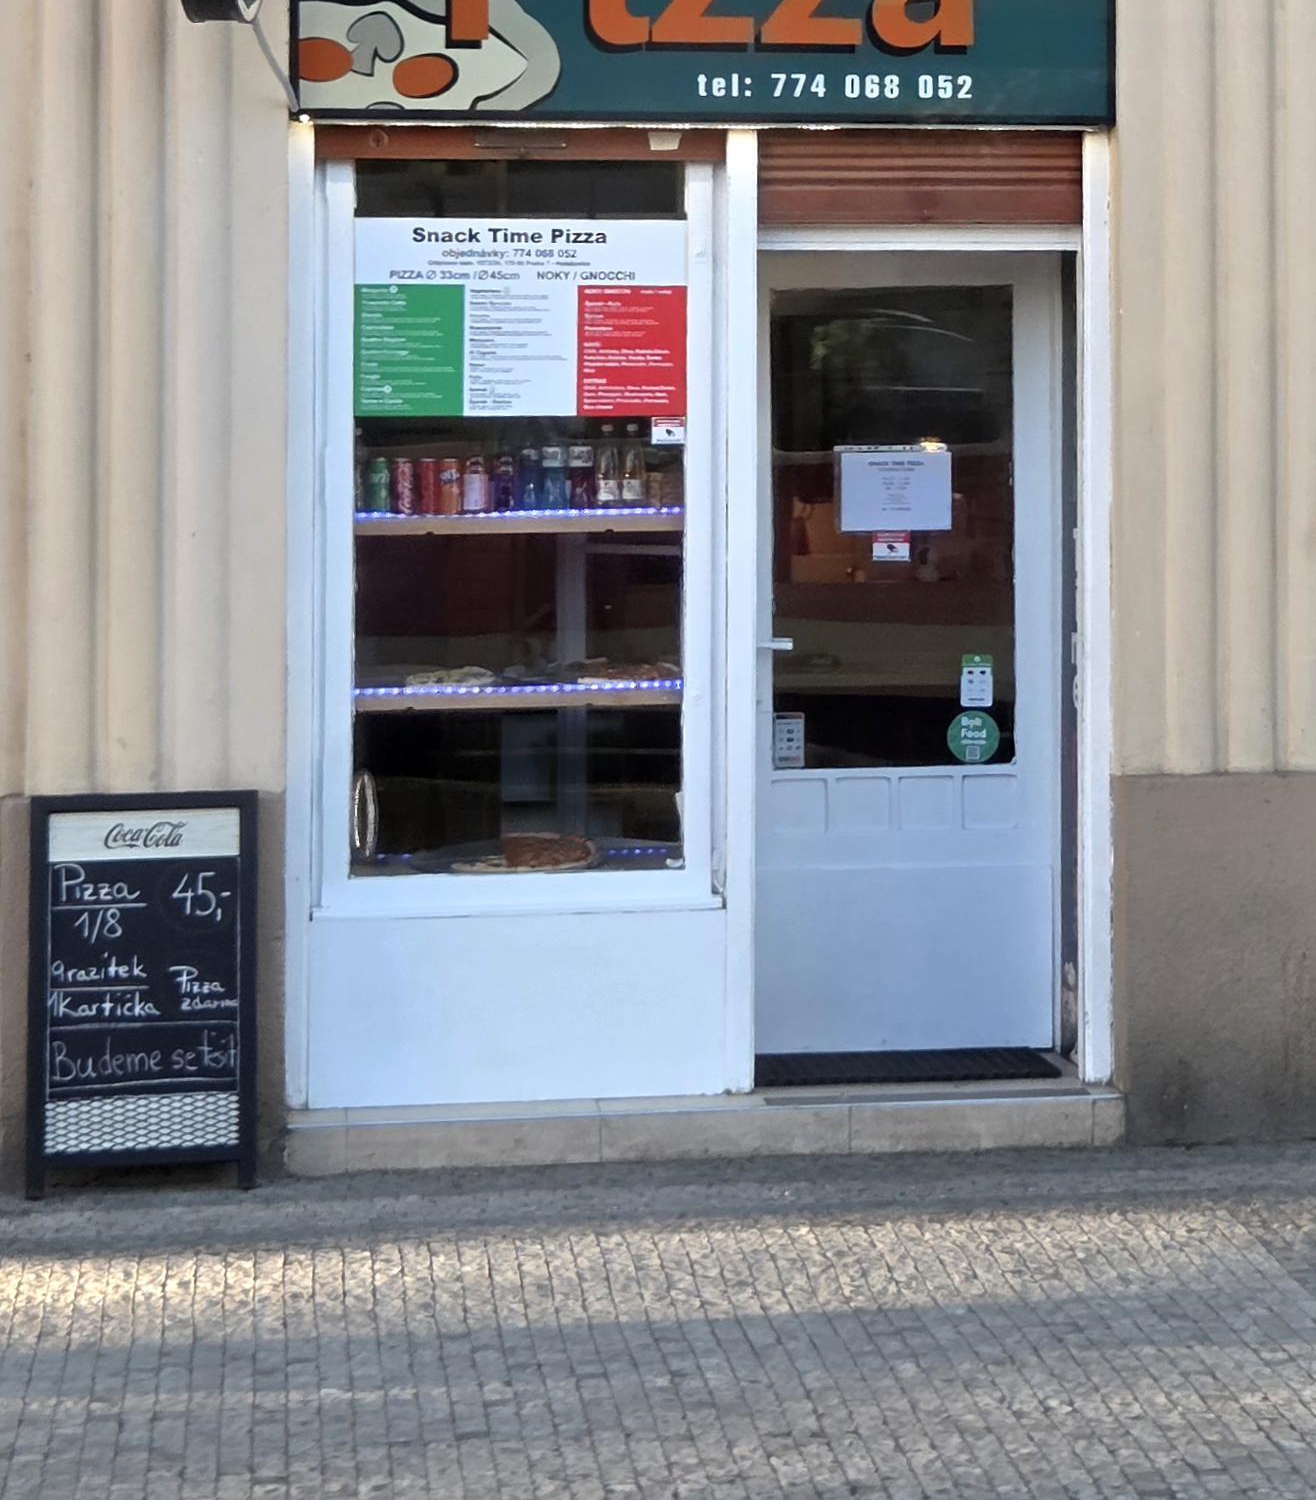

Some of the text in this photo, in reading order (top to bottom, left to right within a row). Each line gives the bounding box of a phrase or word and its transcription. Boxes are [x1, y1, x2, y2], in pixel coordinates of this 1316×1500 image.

[696, 73, 973, 100] tel: 774 068 052
[412, 227, 607, 244] Snack Time Pizza
[442, 249, 508, 260] objednávky:
[513, 249, 531, 258] 774
[557, 249, 577, 258] 052
[389, 270, 423, 280] PIZZA
[440, 270, 470, 280] 33cm
[537, 271, 570, 281] NOKY
[580, 271, 636, 281] GNOCCHI
[104, 821, 188, 850] Coca-Cola
[53, 863, 141, 902] Pizza
[74, 908, 123, 944] 1/8
[168, 966, 226, 994] Pizza
[51, 1036, 164, 1081] Budeme
